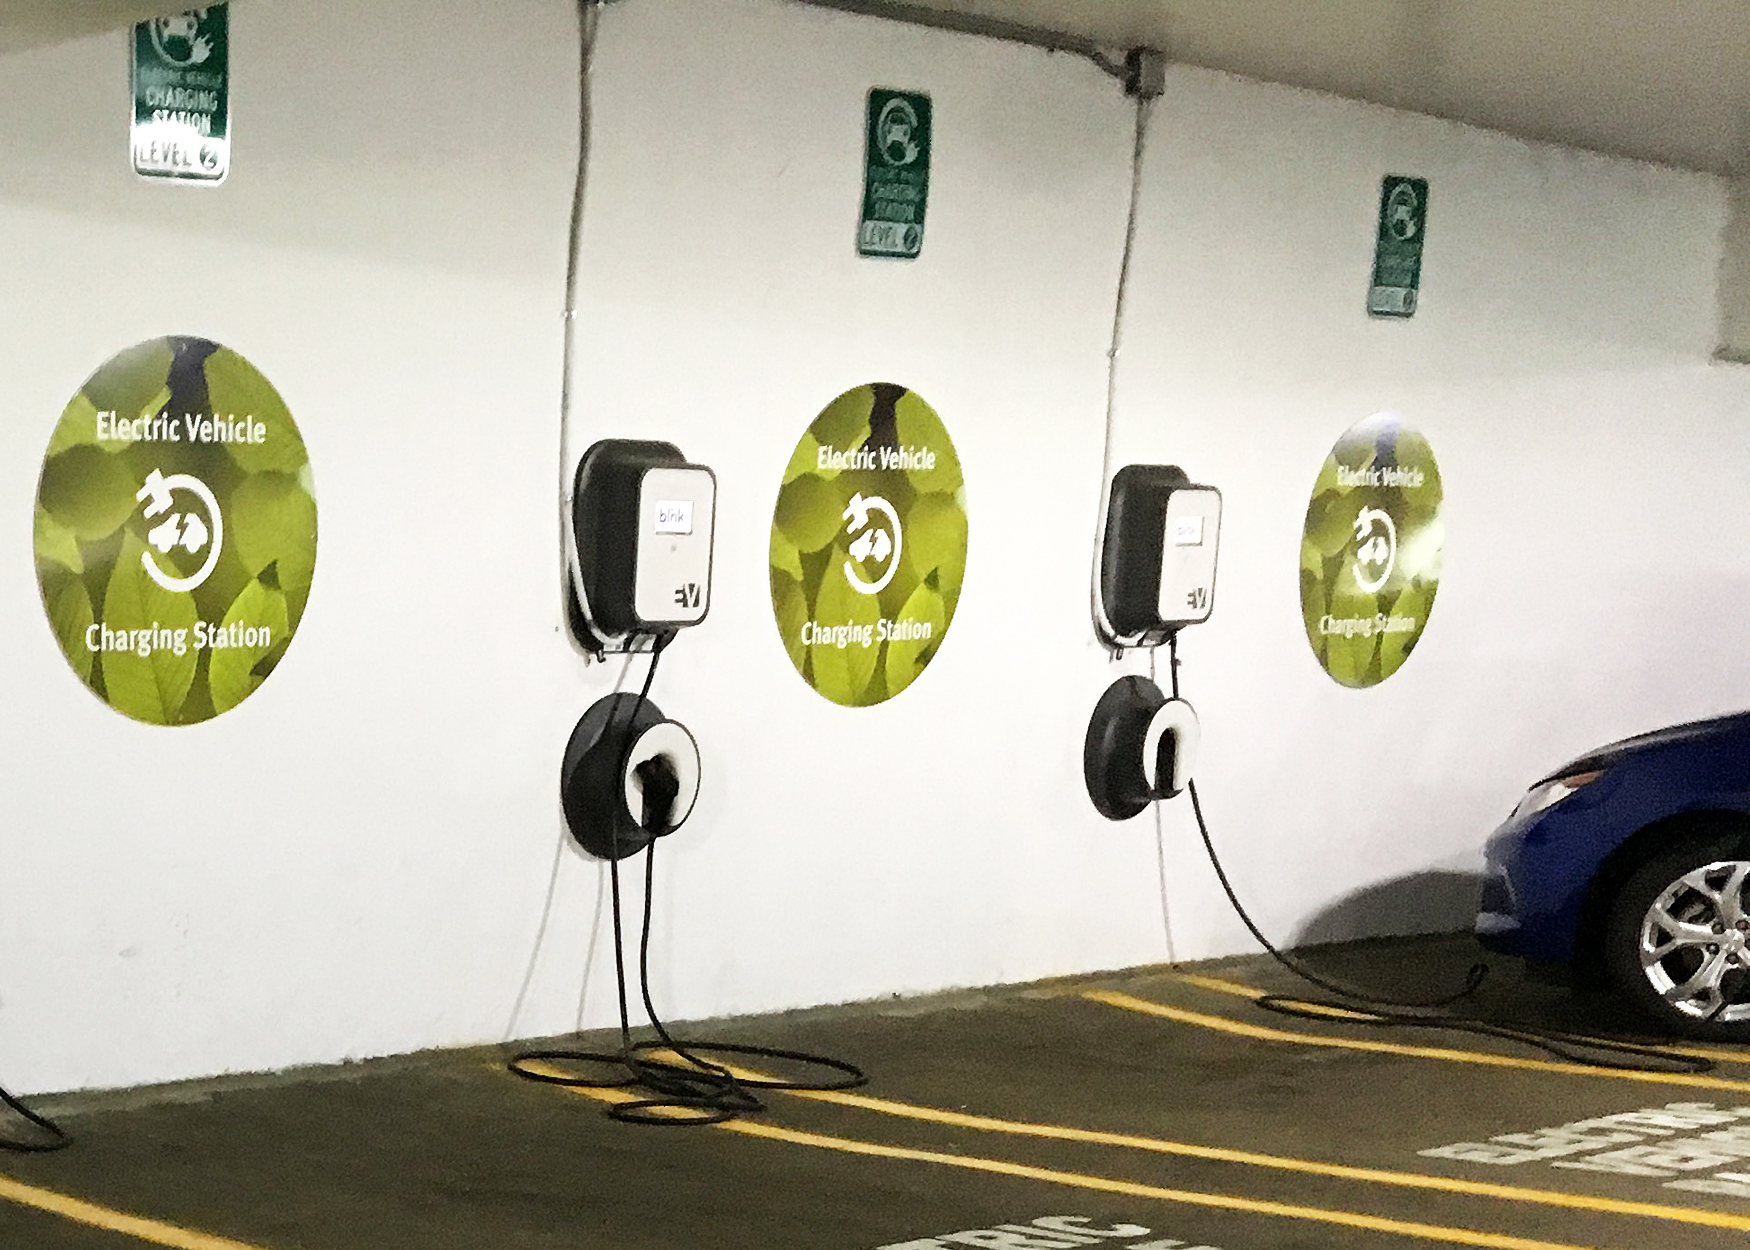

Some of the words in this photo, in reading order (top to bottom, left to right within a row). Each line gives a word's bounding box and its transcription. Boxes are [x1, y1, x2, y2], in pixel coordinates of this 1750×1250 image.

[138, 139, 192, 168] LEVEL
[96, 410, 181, 442] Electric
[184, 412, 267, 444] Vehicle
[817, 445, 877, 470] Electric
[879, 445, 936, 471] Vehicle
[85, 621, 188, 657] Charging
[193, 619, 271, 650] Station
[801, 619, 874, 649] Charging
[876, 616, 932, 642] Station
